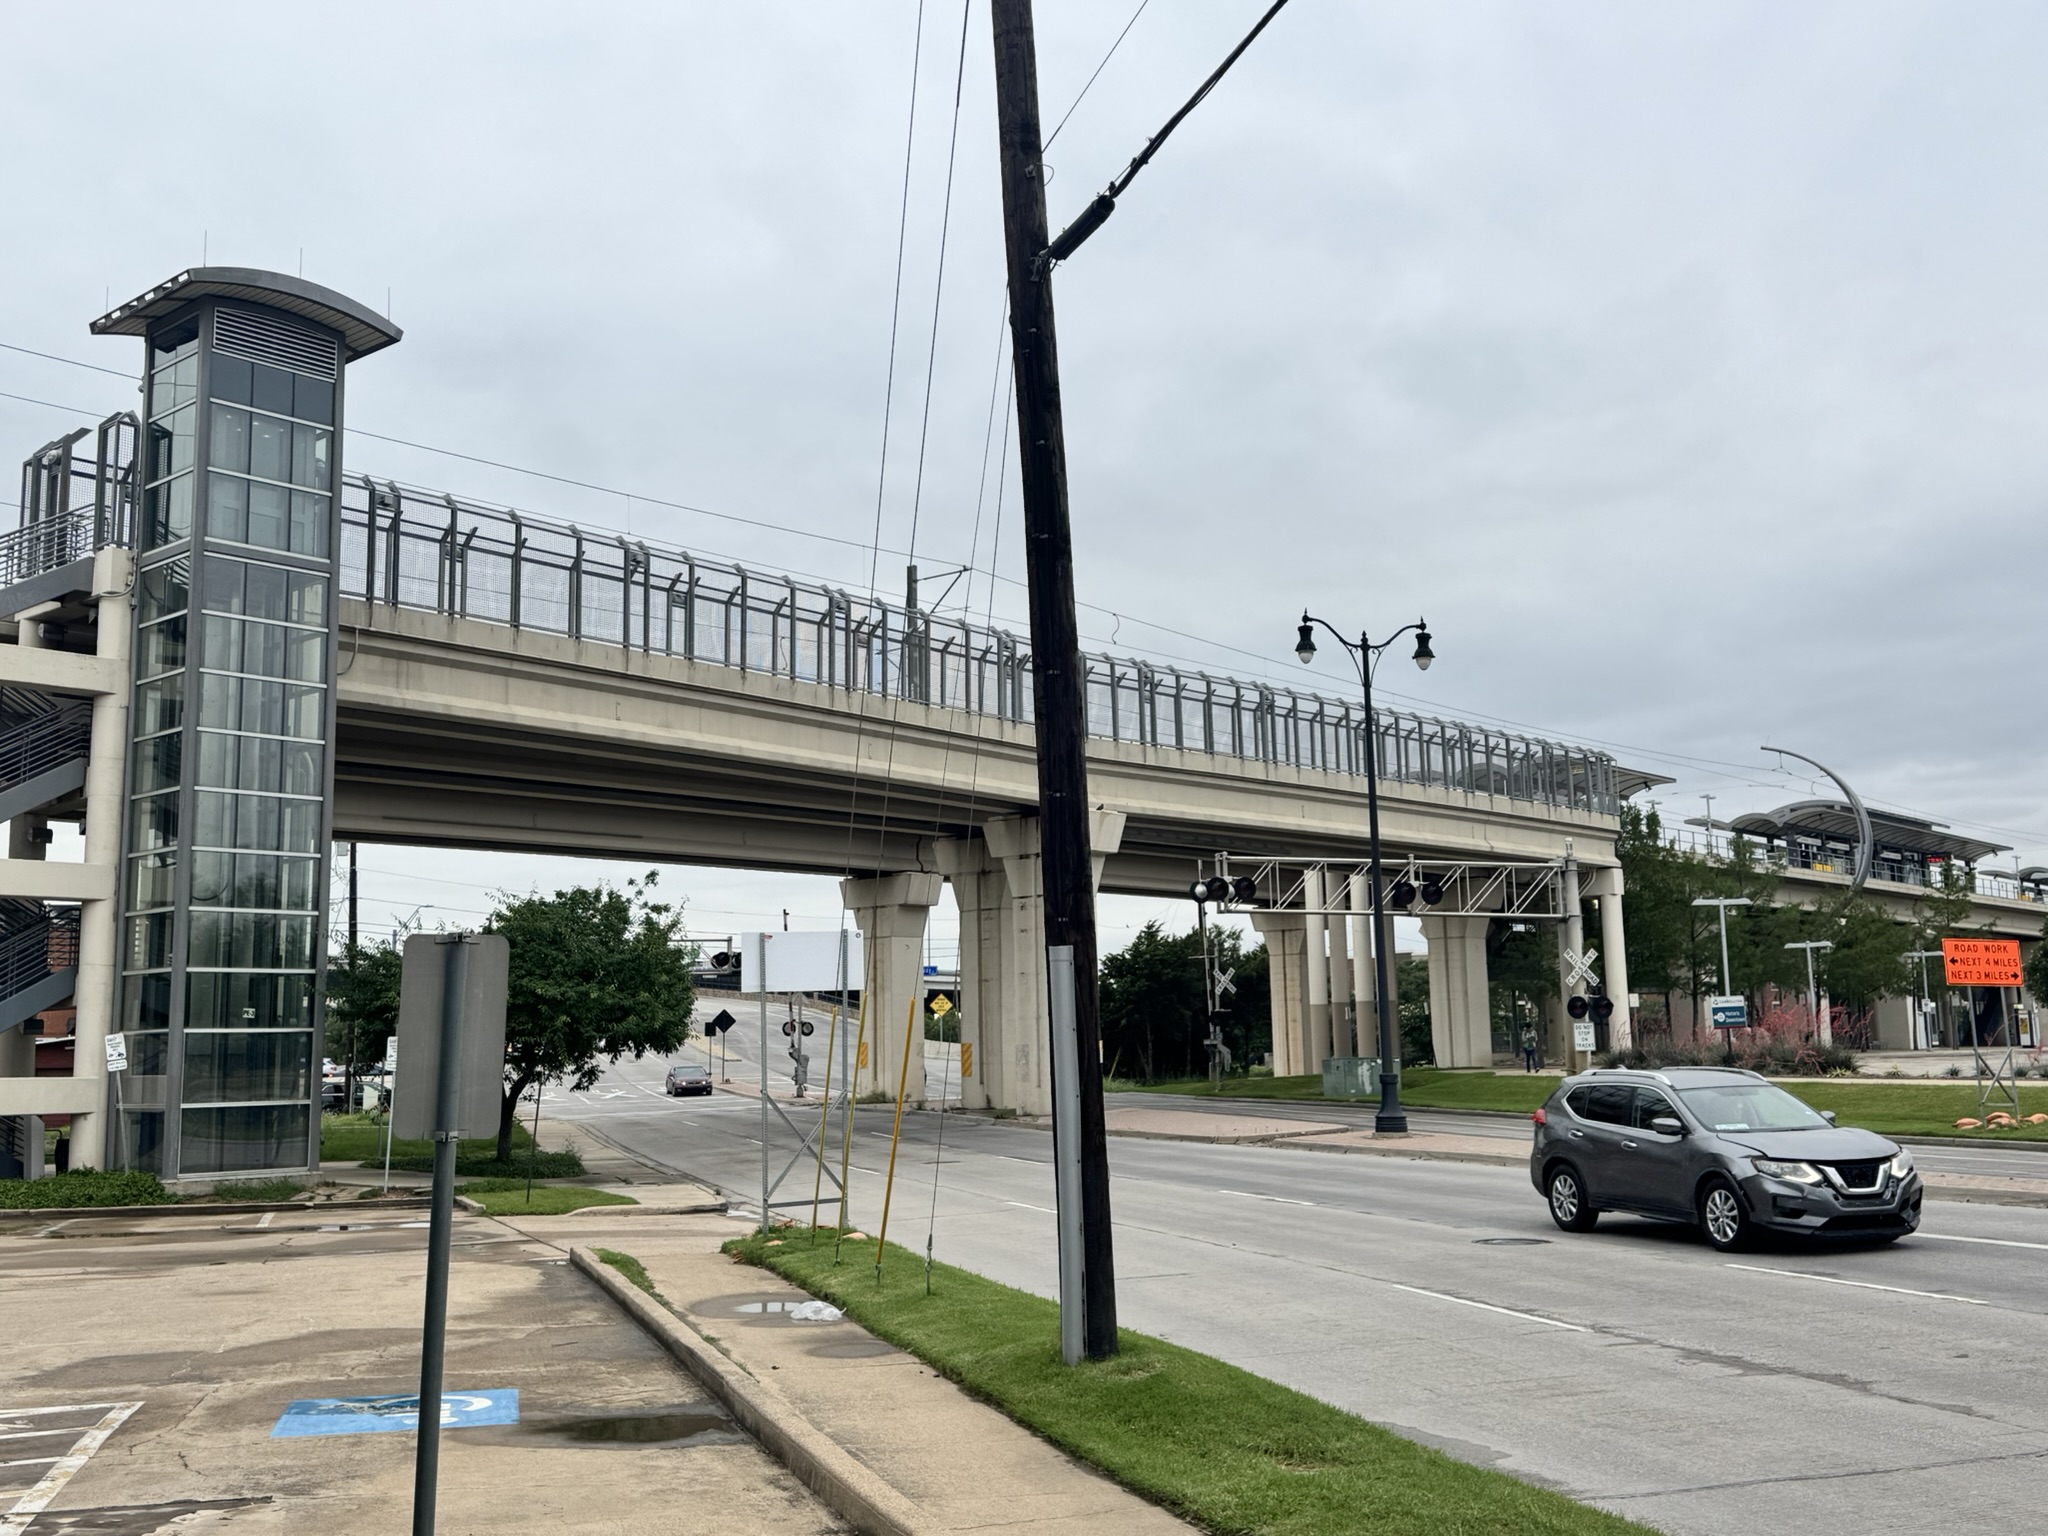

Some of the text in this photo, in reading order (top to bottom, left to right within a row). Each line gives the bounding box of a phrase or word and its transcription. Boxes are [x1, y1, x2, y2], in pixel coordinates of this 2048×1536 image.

[1954, 944, 2009, 954] ROAD WORK
[1565, 950, 1579, 967] RAIL
[1960, 957, 2018, 967] NEXT 4 MILES
[1951, 971, 2010, 980] NEXT 3 MILES
